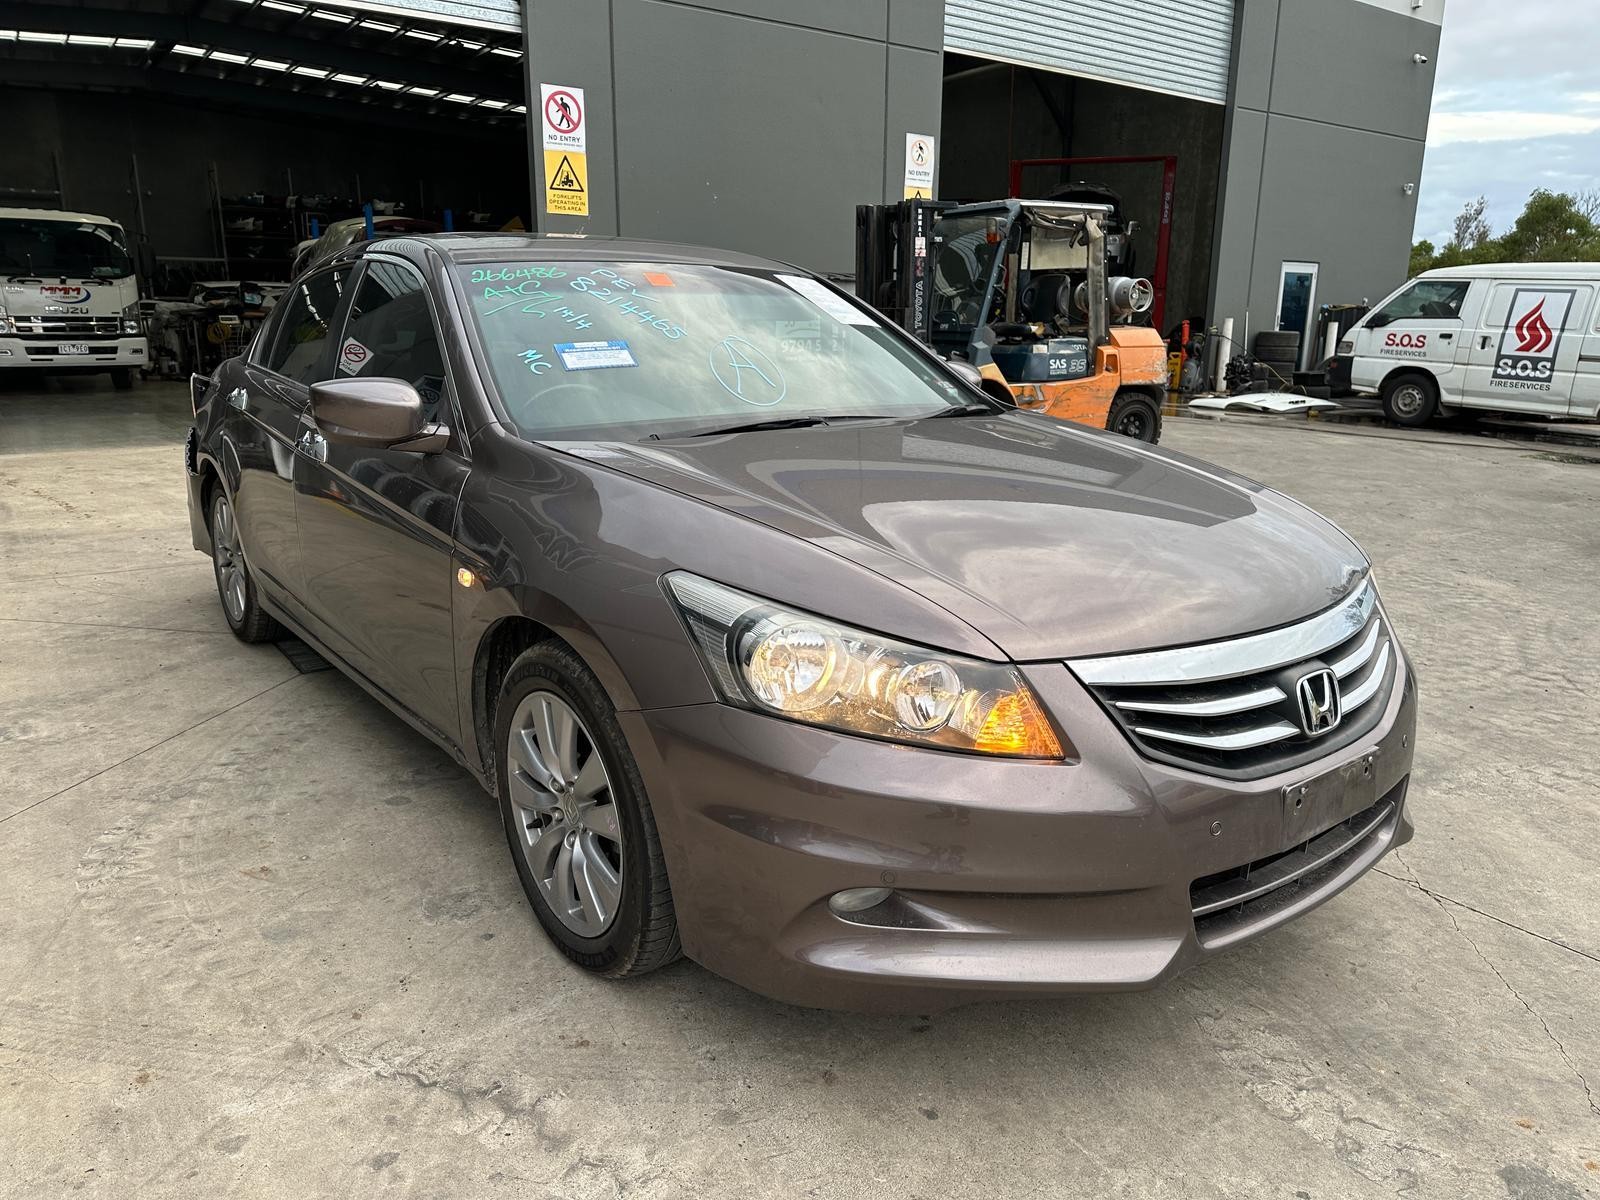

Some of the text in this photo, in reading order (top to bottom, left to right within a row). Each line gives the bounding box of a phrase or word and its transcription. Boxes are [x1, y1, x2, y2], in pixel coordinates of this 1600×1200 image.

[559, 135, 581, 143] ENTRY
[552, 193, 582, 201] FORKLIFTS
[40, 286, 81, 296] MMM
[914, 280, 924, 329] TOYOTA
[45, 305, 89, 315] ISUZU
[1384, 332, 1427, 349] S.O.S
[1049, 358, 1067, 369] SAS
[1496, 358, 1552, 379] S.O.S
